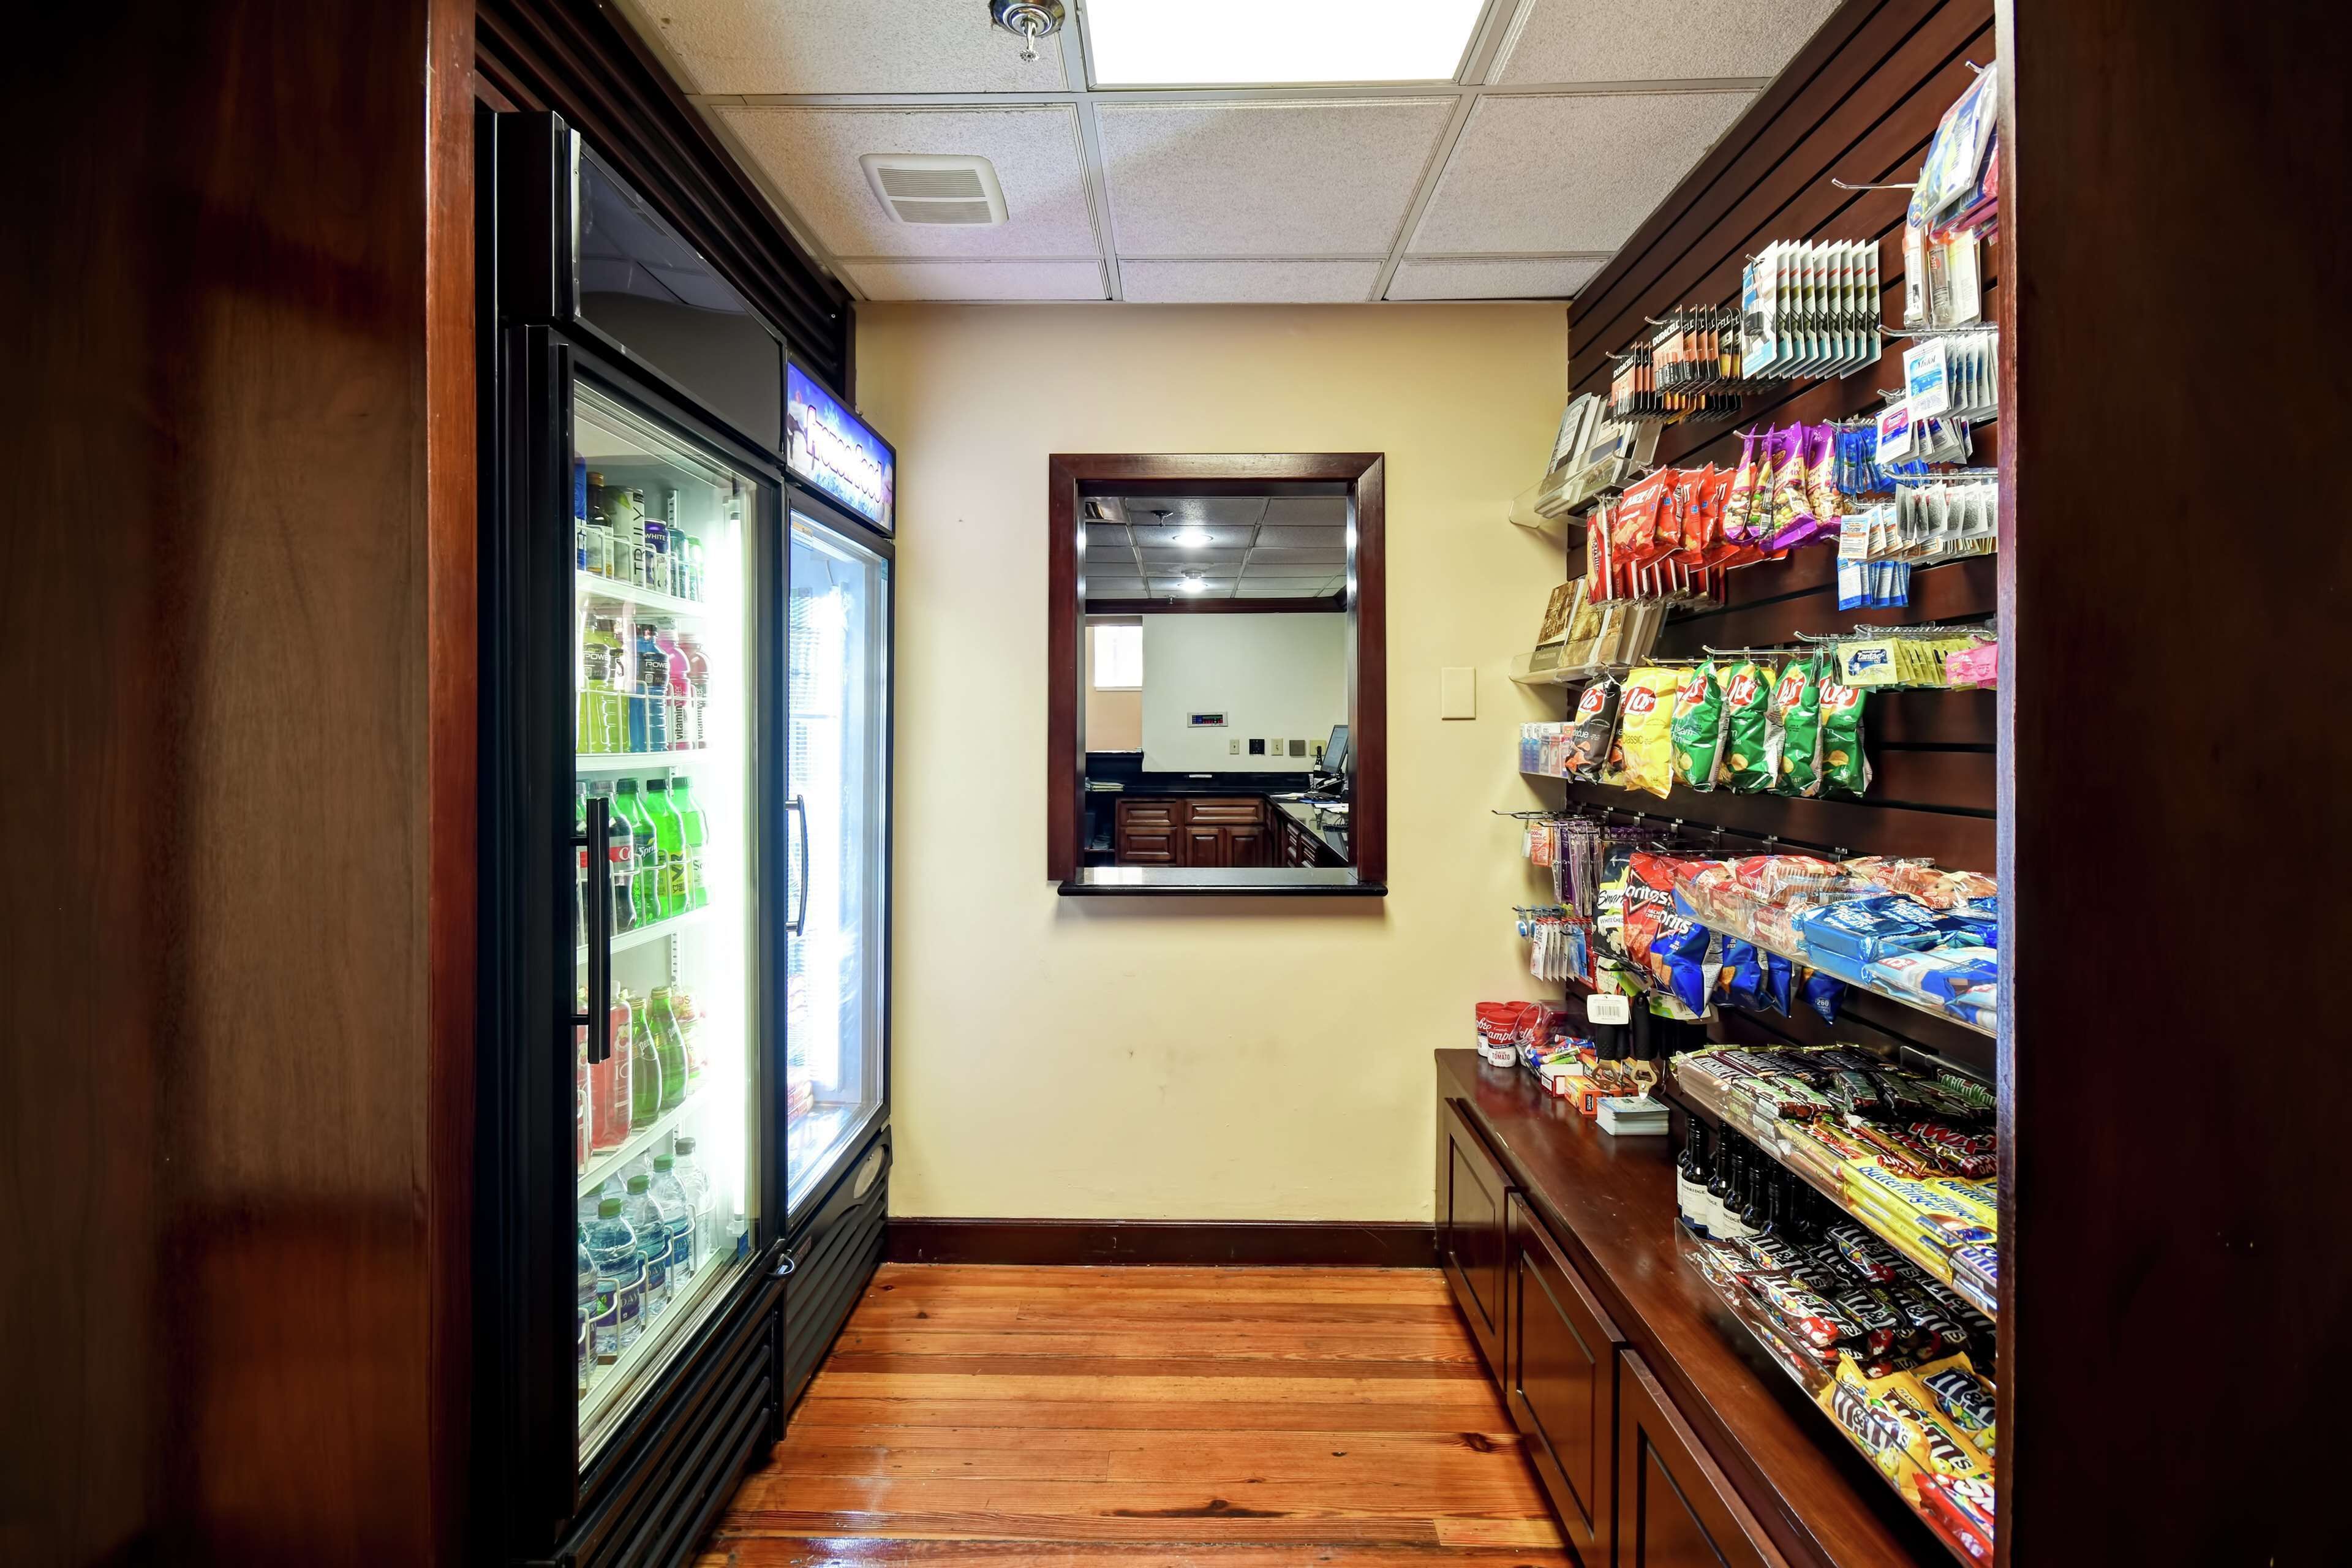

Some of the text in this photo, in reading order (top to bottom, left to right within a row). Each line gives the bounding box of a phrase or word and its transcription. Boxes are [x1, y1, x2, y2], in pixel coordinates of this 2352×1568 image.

[1918, 355, 1936, 368] Midol
[633, 506, 645, 575] TRULY
[645, 532, 666, 542] WHITE
[1857, 652, 1881, 660] Zantac
[1625, 882, 1671, 907] oritos
